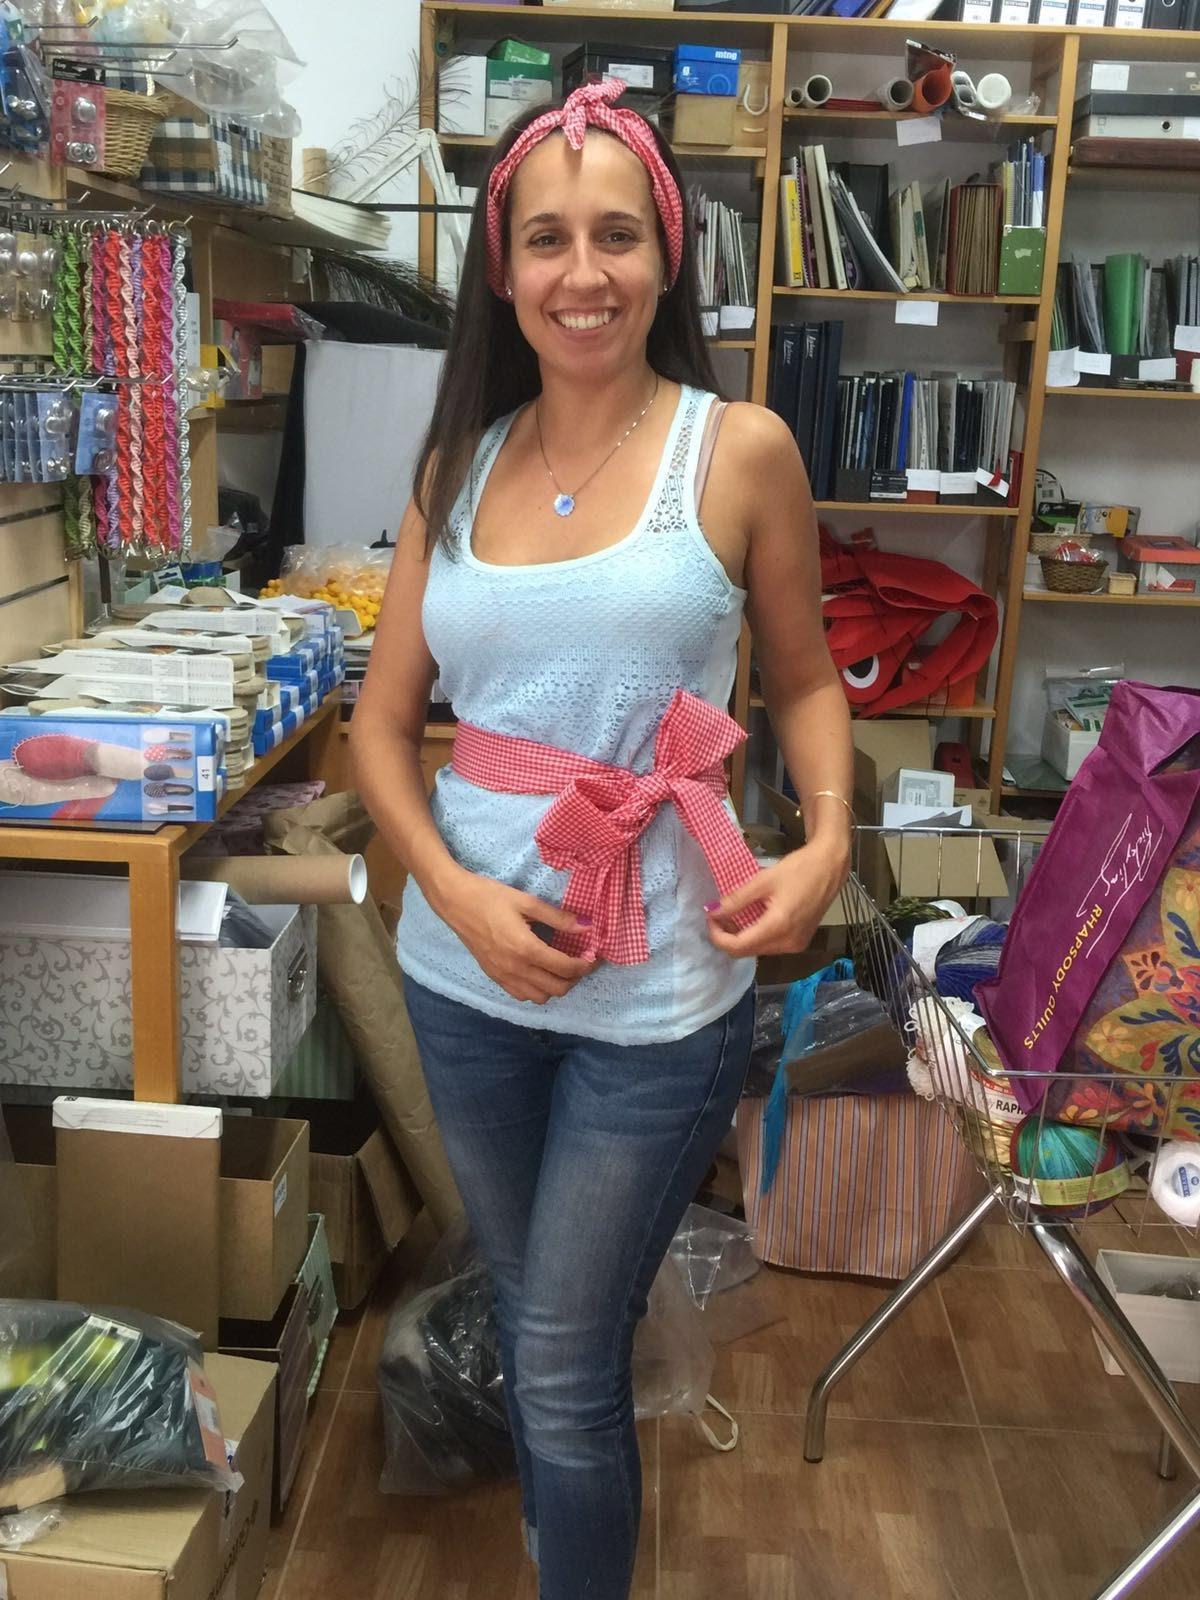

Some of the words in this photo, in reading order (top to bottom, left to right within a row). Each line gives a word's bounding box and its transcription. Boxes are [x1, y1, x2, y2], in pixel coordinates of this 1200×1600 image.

[715, 51, 737, 60] mtng
[201, 769, 209, 779] 41
[1052, 903, 1103, 993] RHAPSODY
[1024, 995, 1056, 1049] QUILTS
[996, 1100, 1027, 1115] RAPH
